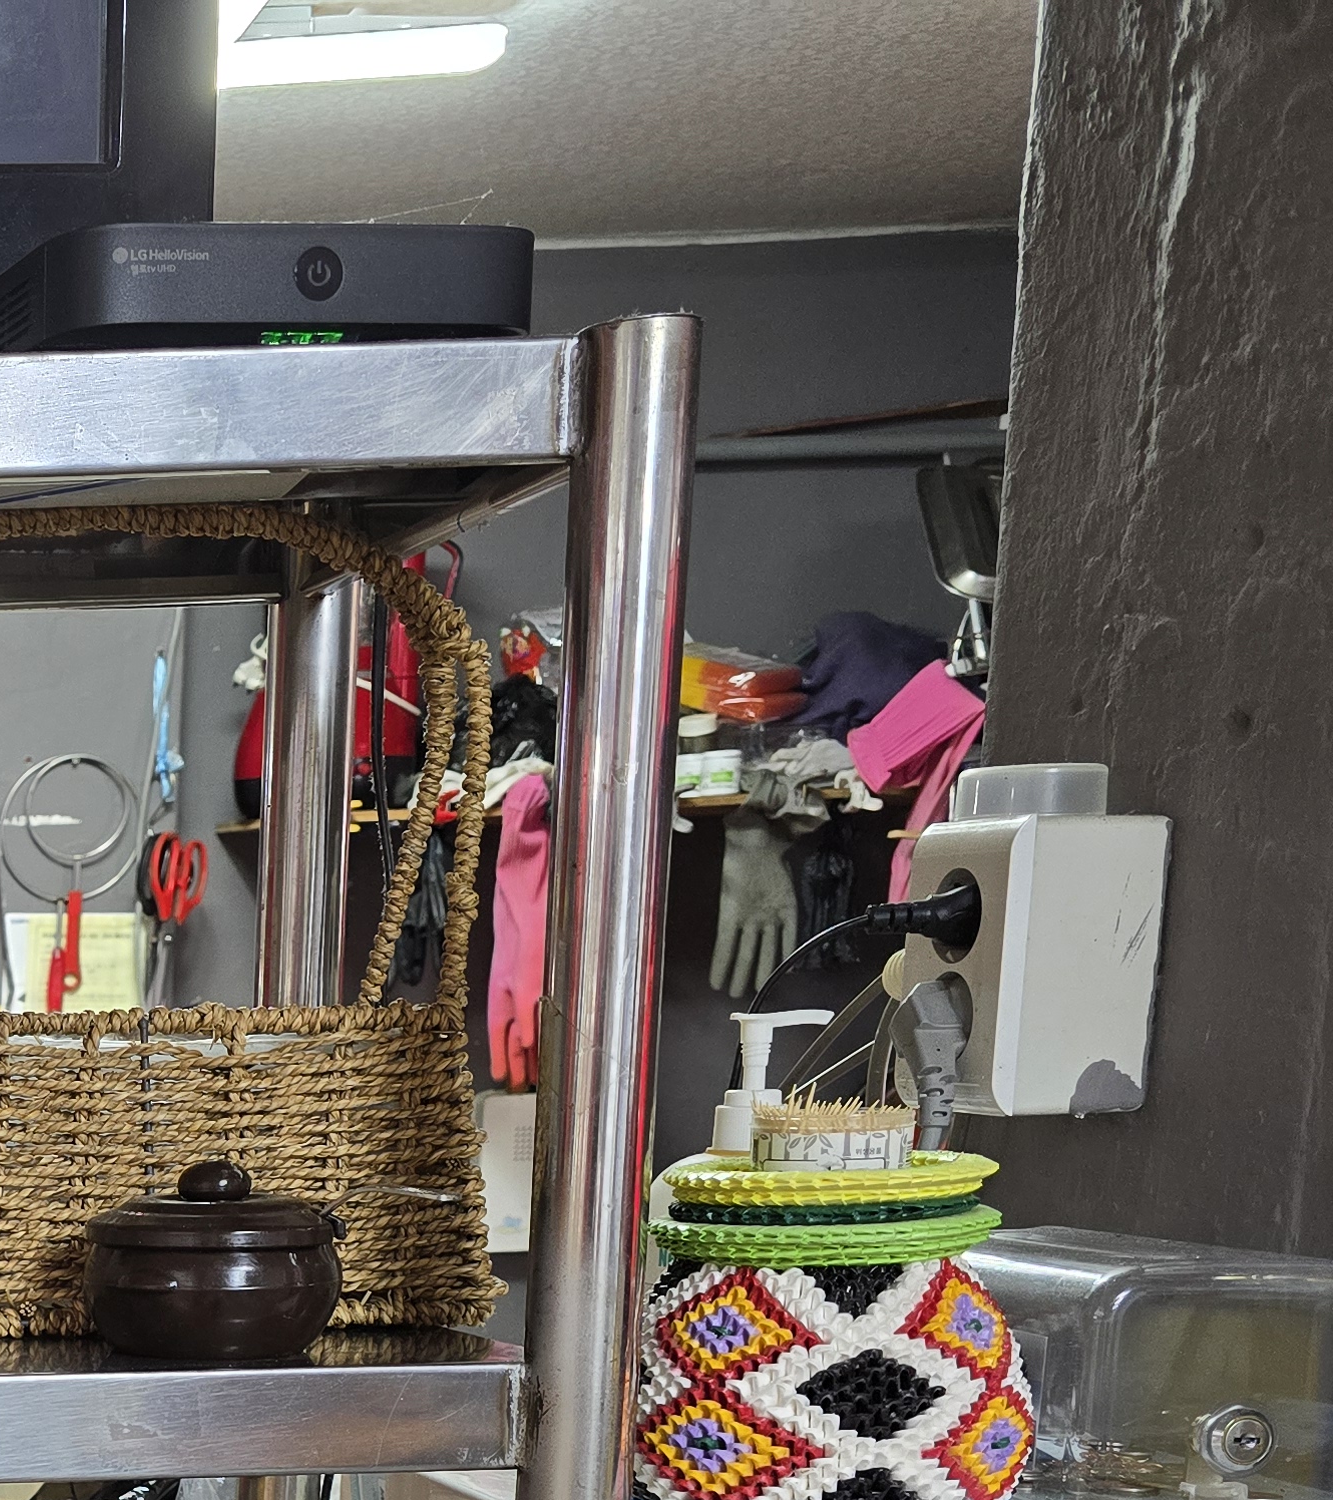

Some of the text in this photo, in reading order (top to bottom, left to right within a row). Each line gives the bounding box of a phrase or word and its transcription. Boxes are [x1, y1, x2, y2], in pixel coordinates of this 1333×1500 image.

[130, 249, 209, 262] LG HelloVision
[157, 264, 176, 273] UHD
